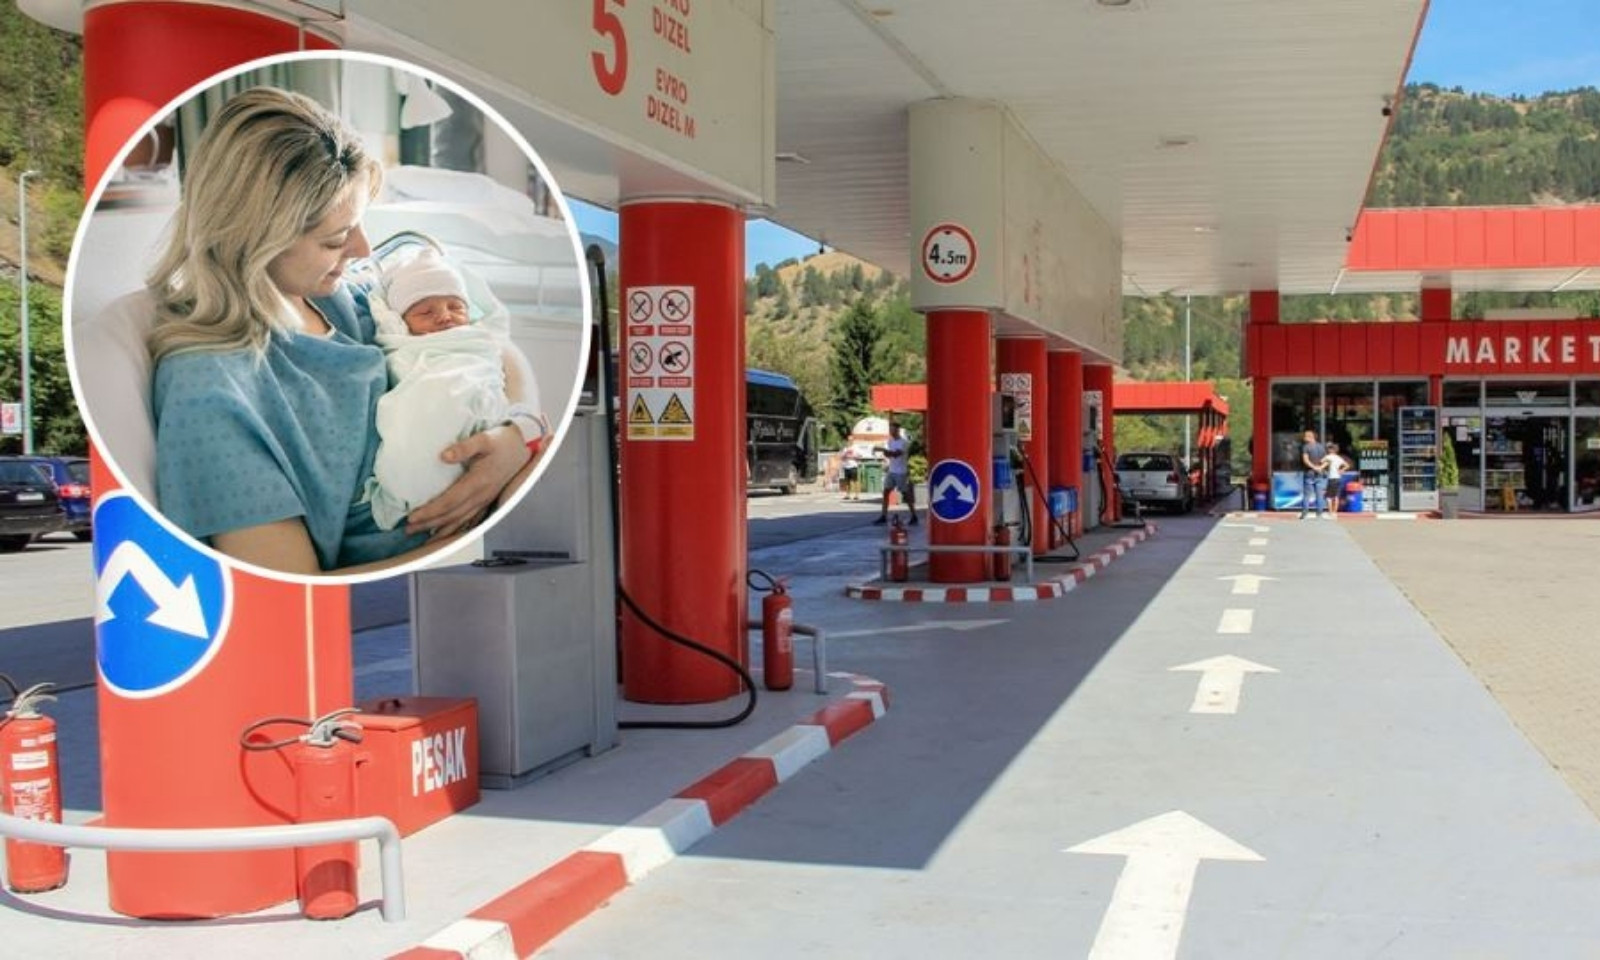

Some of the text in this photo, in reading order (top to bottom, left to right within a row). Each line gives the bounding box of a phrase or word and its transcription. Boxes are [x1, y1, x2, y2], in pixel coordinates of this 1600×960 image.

[591, 0, 628, 96] 5
[653, 5, 691, 53] DIZEL
[656, 67, 687, 104] EVRO
[647, 95, 695, 139] DIZEL M
[929, 243, 967, 265] 4.5m
[1446, 336, 1600, 364] MARKET
[411, 726, 467, 797] PESAK
